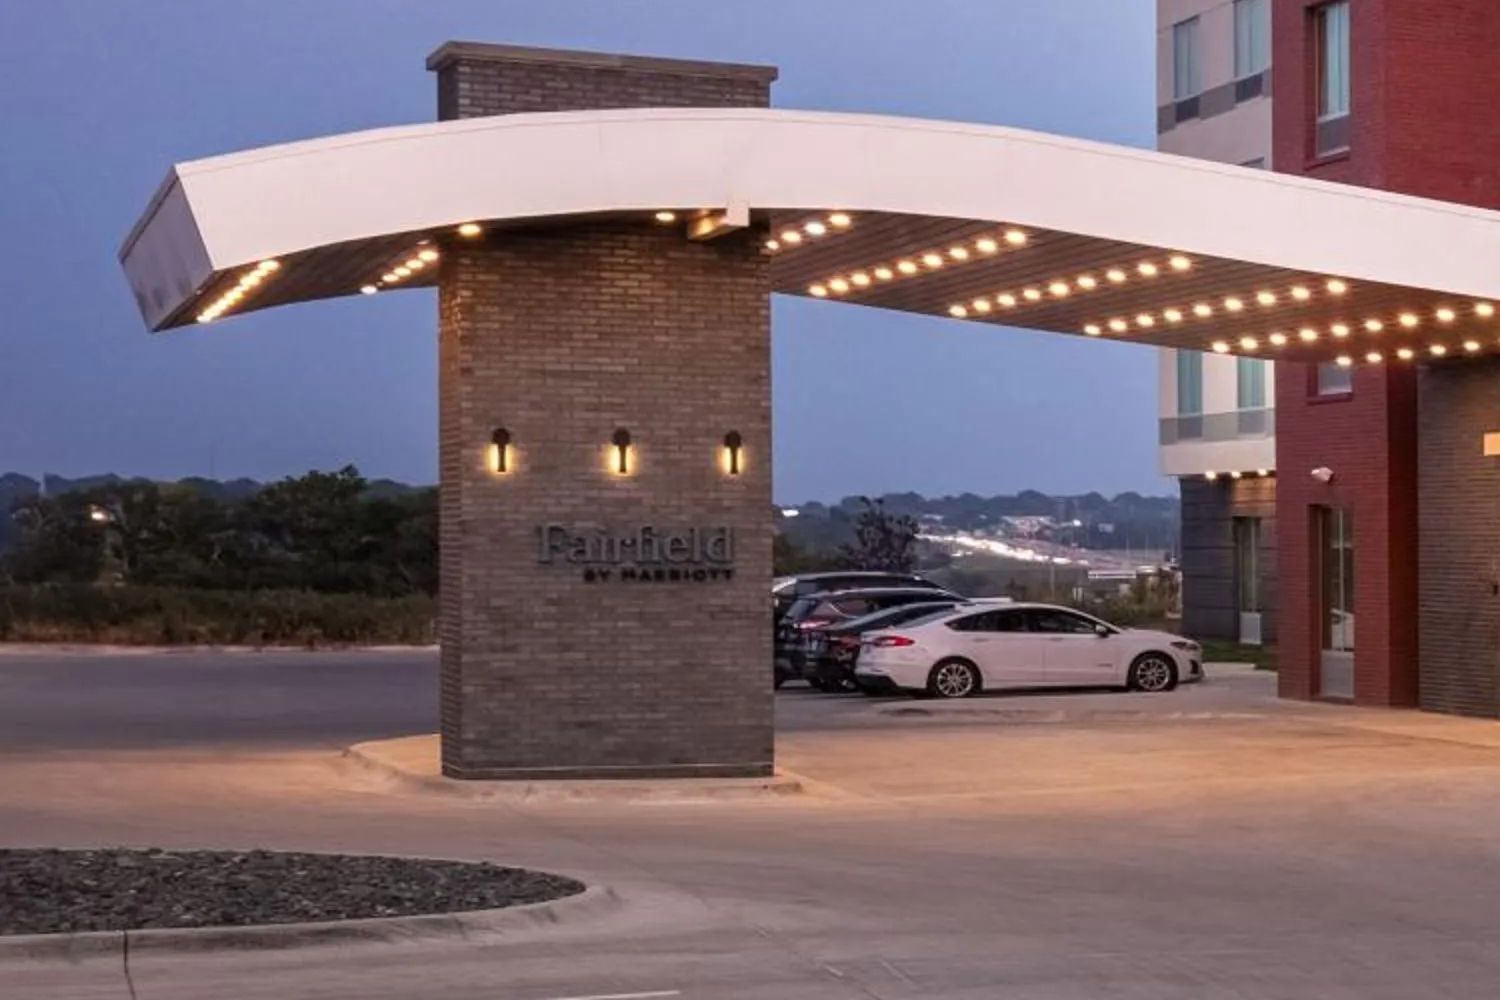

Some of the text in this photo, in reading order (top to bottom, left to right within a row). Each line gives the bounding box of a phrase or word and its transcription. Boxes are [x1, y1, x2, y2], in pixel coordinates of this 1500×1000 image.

[536, 524, 734, 565] Fairfield
[584, 568, 735, 583] BY MARRIOTT
